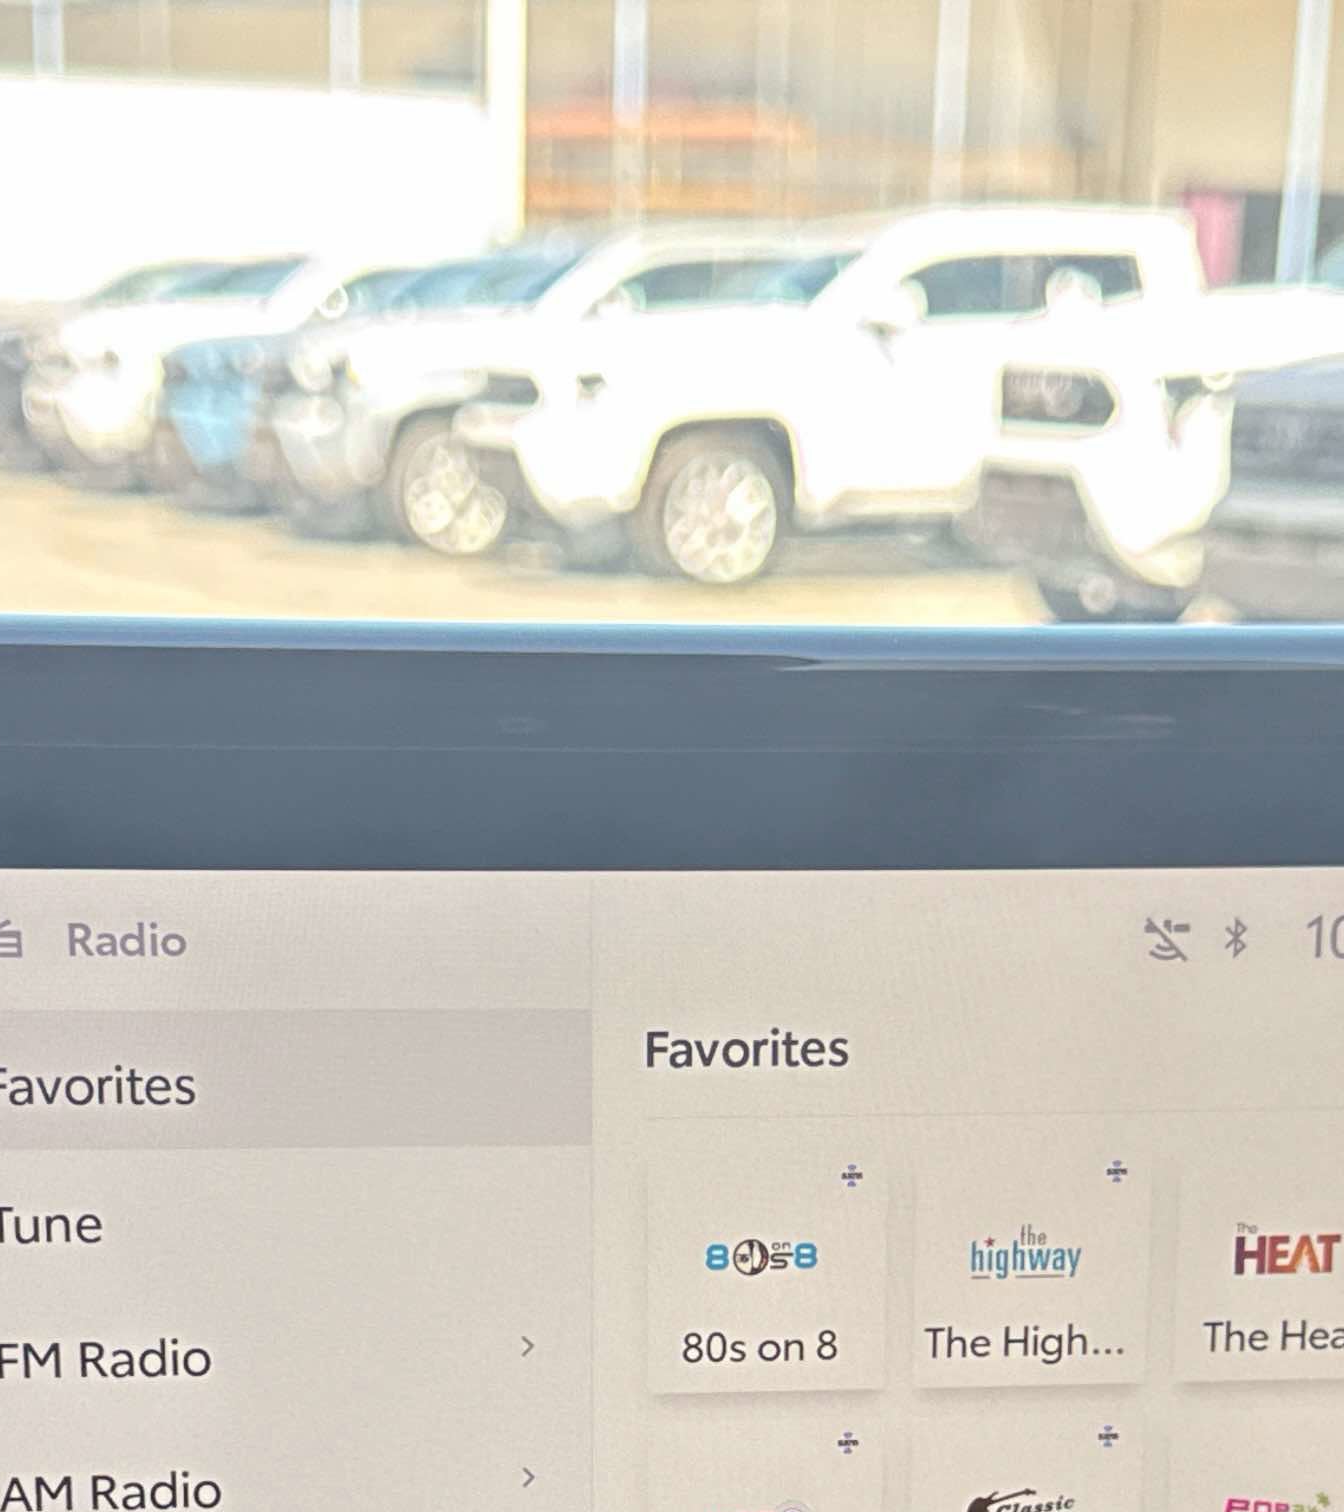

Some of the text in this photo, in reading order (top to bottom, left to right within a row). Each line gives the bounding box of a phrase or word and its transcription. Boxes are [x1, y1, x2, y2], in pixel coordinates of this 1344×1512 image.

[67, 921, 187, 957] Radio
[646, 1027, 849, 1069] Favorites
[1020, 1223, 1047, 1246] the
[1234, 1234, 1342, 1275] HEAT
[970, 1237, 1082, 1280] highway
[682, 1329, 838, 1364] 80s on 8
[924, 1323, 1124, 1365] The High...
[1203, 1320, 1269, 1353] The
[79, 1337, 211, 1378] Radio
[0, 1470, 222, 1512] AM Radio
